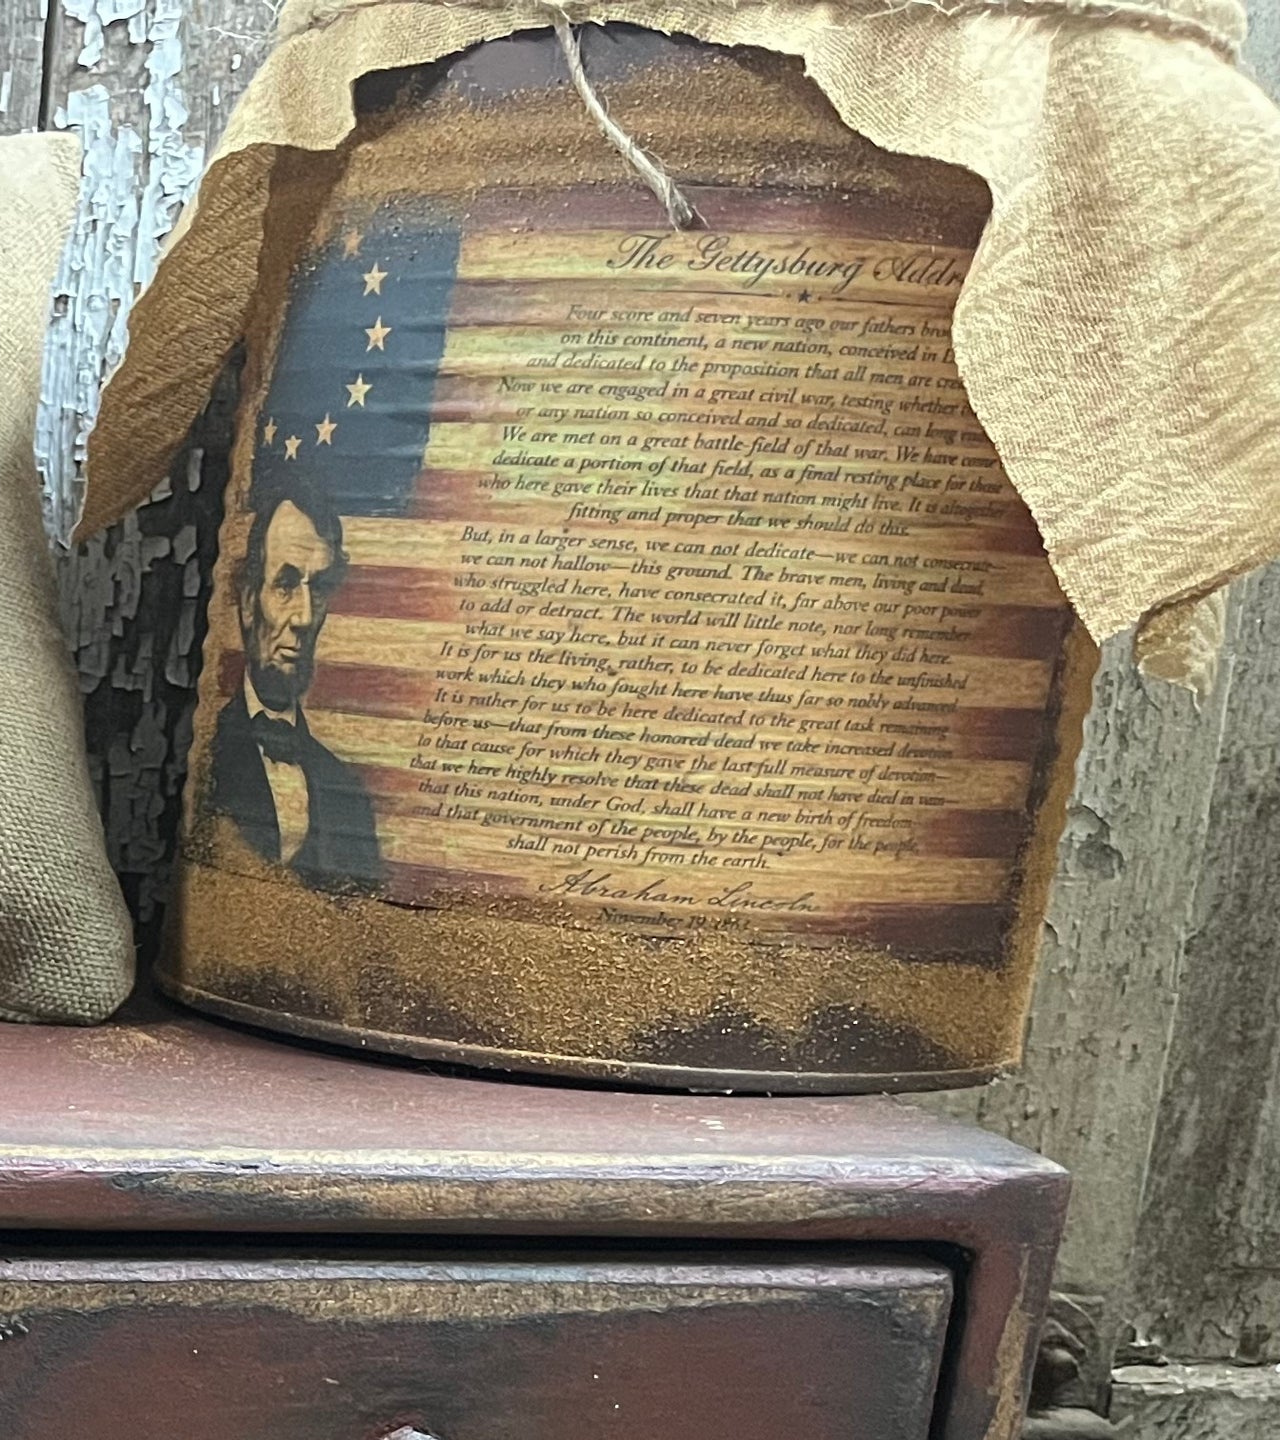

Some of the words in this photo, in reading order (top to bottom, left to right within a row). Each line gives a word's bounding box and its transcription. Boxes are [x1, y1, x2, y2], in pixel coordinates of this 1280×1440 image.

[606, 233, 674, 270] The
[688, 234, 867, 292] Gettysburg
[566, 305, 606, 321] Four
[611, 312, 652, 322] score
[658, 306, 693, 323] and
[695, 313, 741, 324] seven
[746, 315, 791, 330] years
[860, 316, 915, 337] fathers
[587, 329, 618, 346] this
[623, 332, 708, 352] continent,
[772, 338, 832, 358] nation,
[838, 344, 919, 361] conceived
[526, 352, 560, 368] and
[562, 352, 645, 371] dedicated
[701, 361, 798, 380] proposition
[805, 363, 838, 380] that
[870, 373, 903, 385] men
[598, 382, 668, 403] engaged
[708, 388, 754, 405] great
[759, 388, 796, 404] civil
[800, 395, 832, 409] war,
[841, 394, 893, 416] testing
[898, 397, 957, 416] whether
[574, 405, 628, 421] nation
[659, 410, 743, 426] conceived
[806, 414, 887, 438] dedicated,
[894, 426, 920, 437] can
[642, 435, 689, 452] great
[694, 432, 790, 457] battle-field
[815, 440, 848, 458] that
[492, 449, 559, 467] dedicate
[579, 455, 642, 474] portion
[670, 456, 706, 473] that
[709, 458, 753, 480] field,
[796, 464, 841, 486] final
[843, 470, 897, 492] resting
[901, 472, 940, 493] place
[514, 473, 548, 491] here
[553, 482, 593, 497] gave
[597, 478, 636, 496] their
[641, 480, 678, 498] lives
[684, 483, 719, 500] that
[724, 485, 757, 502] that
[762, 489, 816, 506] nation
[821, 492, 867, 513] might
[872, 494, 901, 512] live.
[566, 502, 622, 525] fitting
[664, 513, 724, 529] proper
[727, 510, 763, 527] that
[795, 514, 852, 533] should
[878, 519, 910, 537] this.
[461, 525, 492, 545] But,
[535, 529, 586, 551] larger
[589, 538, 637, 554] sense,
[894, 554, 918, 568] not
[490, 577, 568, 598] struggled
[571, 579, 611, 600] here,
[619, 582, 659, 600] have
[664, 590, 766, 606] consecrated
[789, 592, 818, 614] far
[823, 595, 868, 612] above
[903, 605, 938, 620] poor
[666, 563, 732, 581] ground.
[742, 564, 772, 582] The
[778, 567, 824, 585] brave
[873, 572, 914, 596] living
[539, 600, 602, 620] detract.
[650, 609, 701, 625] world
[706, 611, 739, 628] will
[743, 613, 782, 631] little
[788, 620, 826, 637] note,
[833, 625, 860, 636] nor
[465, 619, 504, 637] what
[570, 626, 610, 648] here,
[669, 639, 698, 650] can
[705, 641, 750, 653] never
[752, 638, 806, 661] forget
[810, 641, 850, 659] what
[855, 644, 886, 666] they
[558, 649, 610, 673] living,
[618, 655, 673, 676] rather,
[727, 660, 808, 680] dedicated
[811, 665, 846, 683] here
[870, 669, 893, 686] the
[435, 666, 475, 682] work
[478, 668, 524, 686] which
[531, 671, 566, 694] they
[608, 677, 666, 701] fought
[671, 681, 708, 699] here
[714, 683, 752, 701] have
[757, 687, 792, 704] thus
[848, 692, 888, 714] nobly
[423, 708, 470, 731] before
[544, 719, 586, 740] from
[592, 723, 635, 741] these
[640, 726, 715, 746] honored
[714, 731, 756, 749] dead
[786, 737, 820, 754] take
[825, 739, 895, 757] increased
[469, 691, 518, 709] rather
[519, 693, 547, 715] for
[622, 701, 657, 720] here
[663, 704, 746, 725] dedicated
[799, 718, 840, 734] great
[844, 717, 876, 733] task
[436, 732, 467, 750] that
[472, 742, 514, 755] cause
[550, 744, 600, 763] which
[604, 748, 640, 771] they
[644, 757, 684, 772] gave
[790, 766, 855, 779] measure
[410, 753, 436, 771] that
[468, 758, 501, 777] here
[506, 762, 557, 787] highly
[561, 770, 618, 787] resolve
[624, 773, 660, 791] that
[662, 775, 705, 793] these
[710, 778, 753, 796] dead
[754, 781, 795, 798] shall
[798, 787, 824, 800] not
[828, 785, 864, 803] have
[867, 787, 899, 804] died
[419, 777, 448, 795] that
[454, 781, 482, 799] this
[487, 788, 542, 809] nation,
[550, 793, 600, 810] under
[651, 799, 694, 817] shall
[697, 801, 736, 820] have
[795, 808, 832, 826] birth
[445, 803, 481, 822] that
[482, 813, 582, 832] government
[610, 819, 637, 836] the
[641, 824, 700, 844] people,
[761, 831, 816, 852] people,
[507, 833, 548, 852] shall
[584, 844, 637, 862] perish
[640, 846, 684, 867] from
[691, 849, 717, 866] the
[722, 853, 769, 870] earth.
[539, 869, 702, 905] Abraham
[707, 881, 820, 912] Lincoln
[596, 907, 683, 926] November
